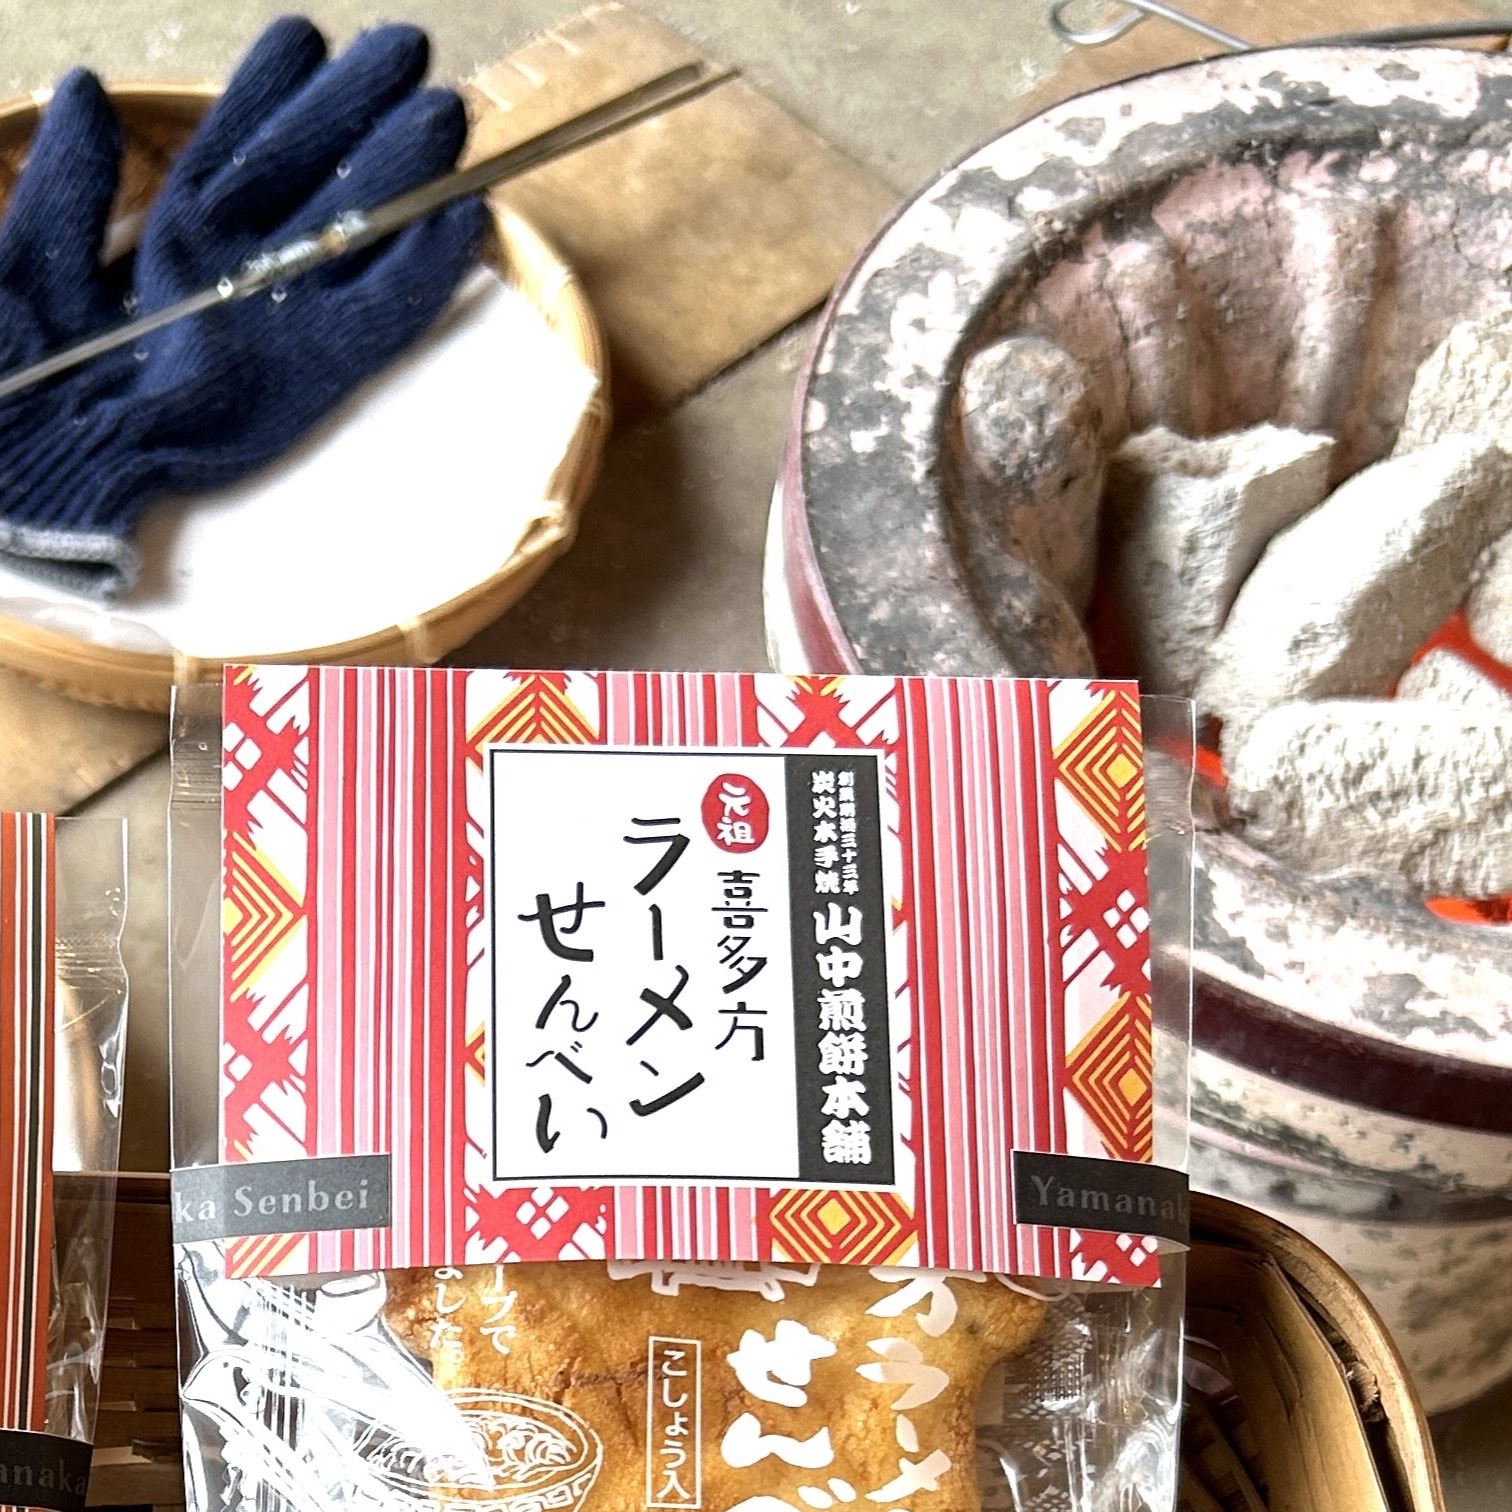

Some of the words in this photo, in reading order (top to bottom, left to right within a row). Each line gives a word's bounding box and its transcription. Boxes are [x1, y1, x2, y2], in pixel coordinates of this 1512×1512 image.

[717, 782, 756, 847] 元祖
[517, 879, 609, 1154] せんべい
[622, 816, 706, 1117] ラーメン
[711, 869, 769, 1062] 喜多方
[812, 901, 872, 1166] 山中煎餅本舗
[232, 1178, 369, 1217] Senbei
[654, 1348, 692, 1500] こしょう入
